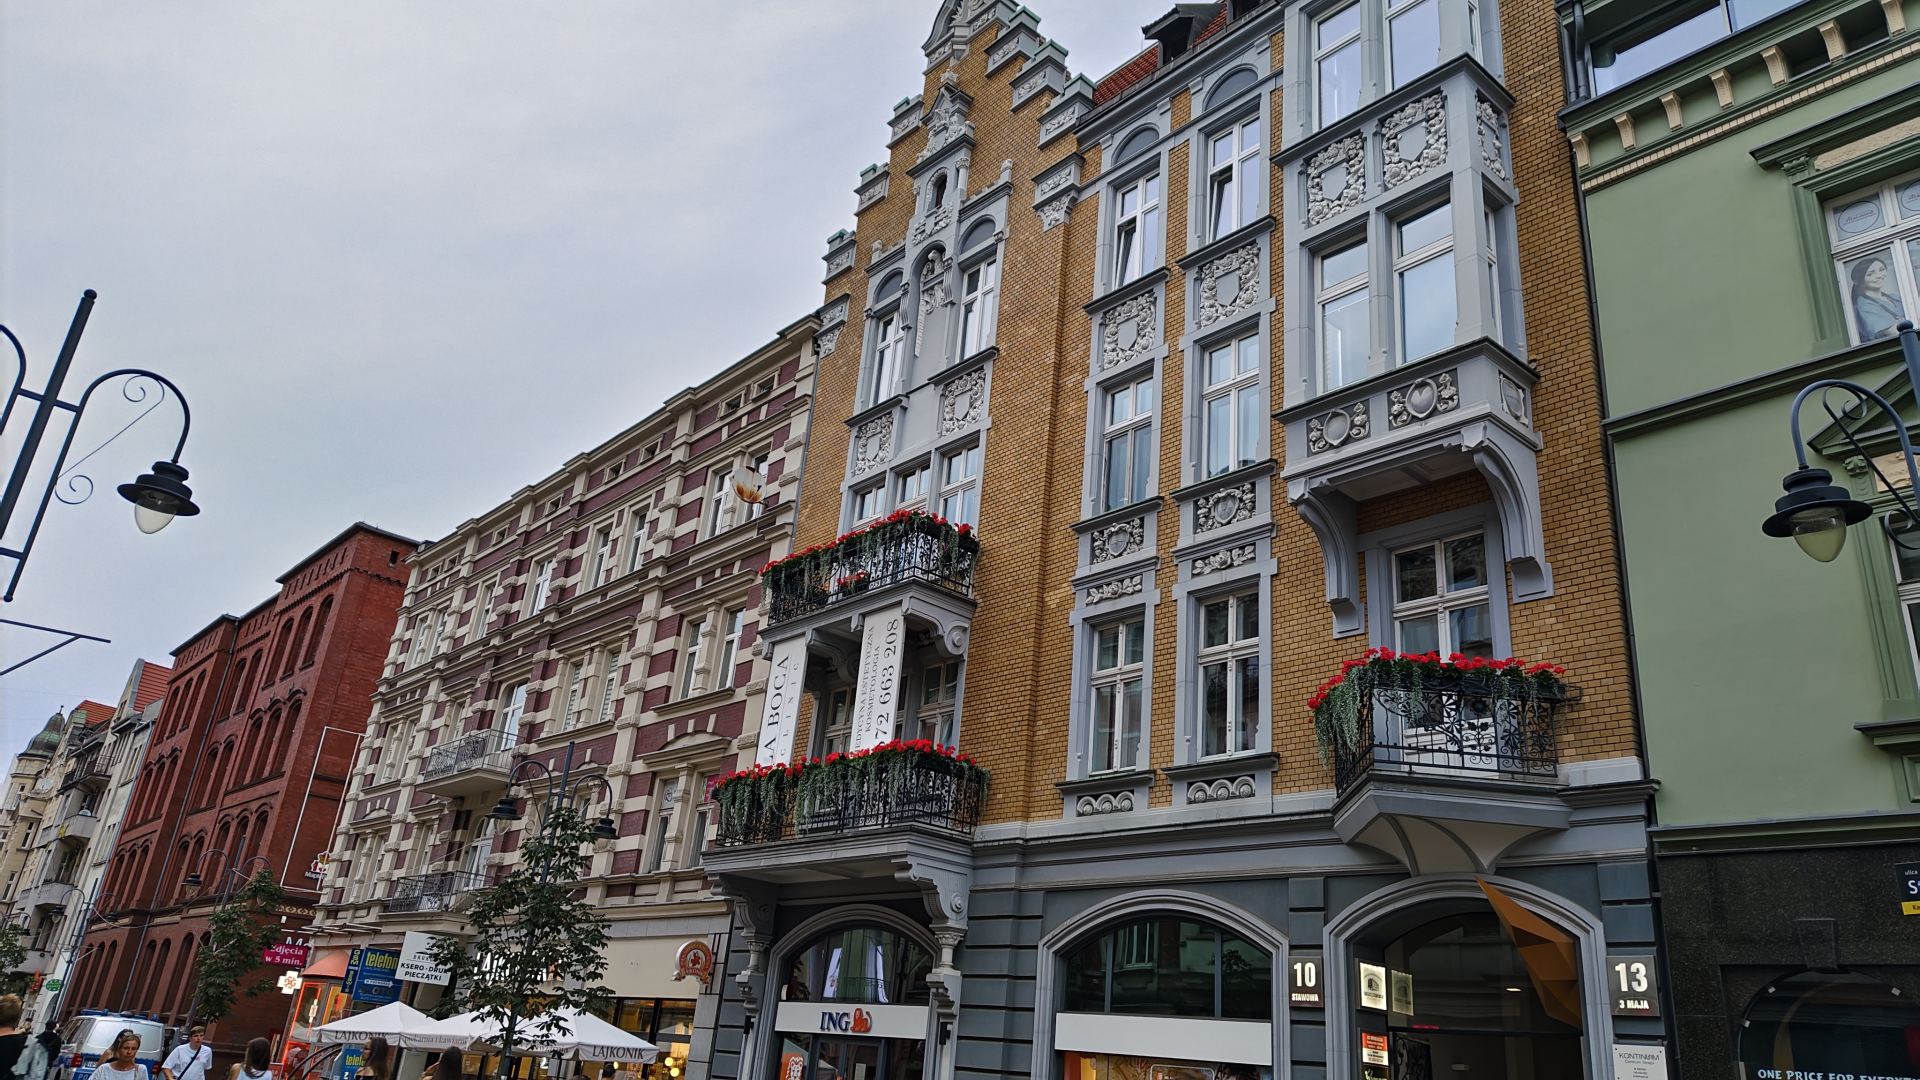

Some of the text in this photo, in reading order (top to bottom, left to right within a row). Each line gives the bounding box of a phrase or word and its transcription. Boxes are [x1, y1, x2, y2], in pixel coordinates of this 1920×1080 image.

[862, 626, 875, 695] ESTETYCZNA
[866, 646, 880, 732] KOSMETOLOGIA
[875, 619, 898, 745] 72 663 208
[767, 655, 789, 729] BOCA
[282, 958, 303, 966] min.
[400, 962, 425, 971] KSERO
[404, 971, 442, 981] PIECZĄTKI
[1293, 962, 1316, 987] 10
[1615, 962, 1648, 992] 13
[1291, 993, 1319, 1002] STAWOWA
[1619, 1000, 1650, 1009] 3 MAJA
[819, 1011, 851, 1032] ING
[592, 1045, 646, 1059] LAJKONIK
[1757, 1069, 1782, 1080] ONE
[1786, 1070, 1824, 1080] PRICE
